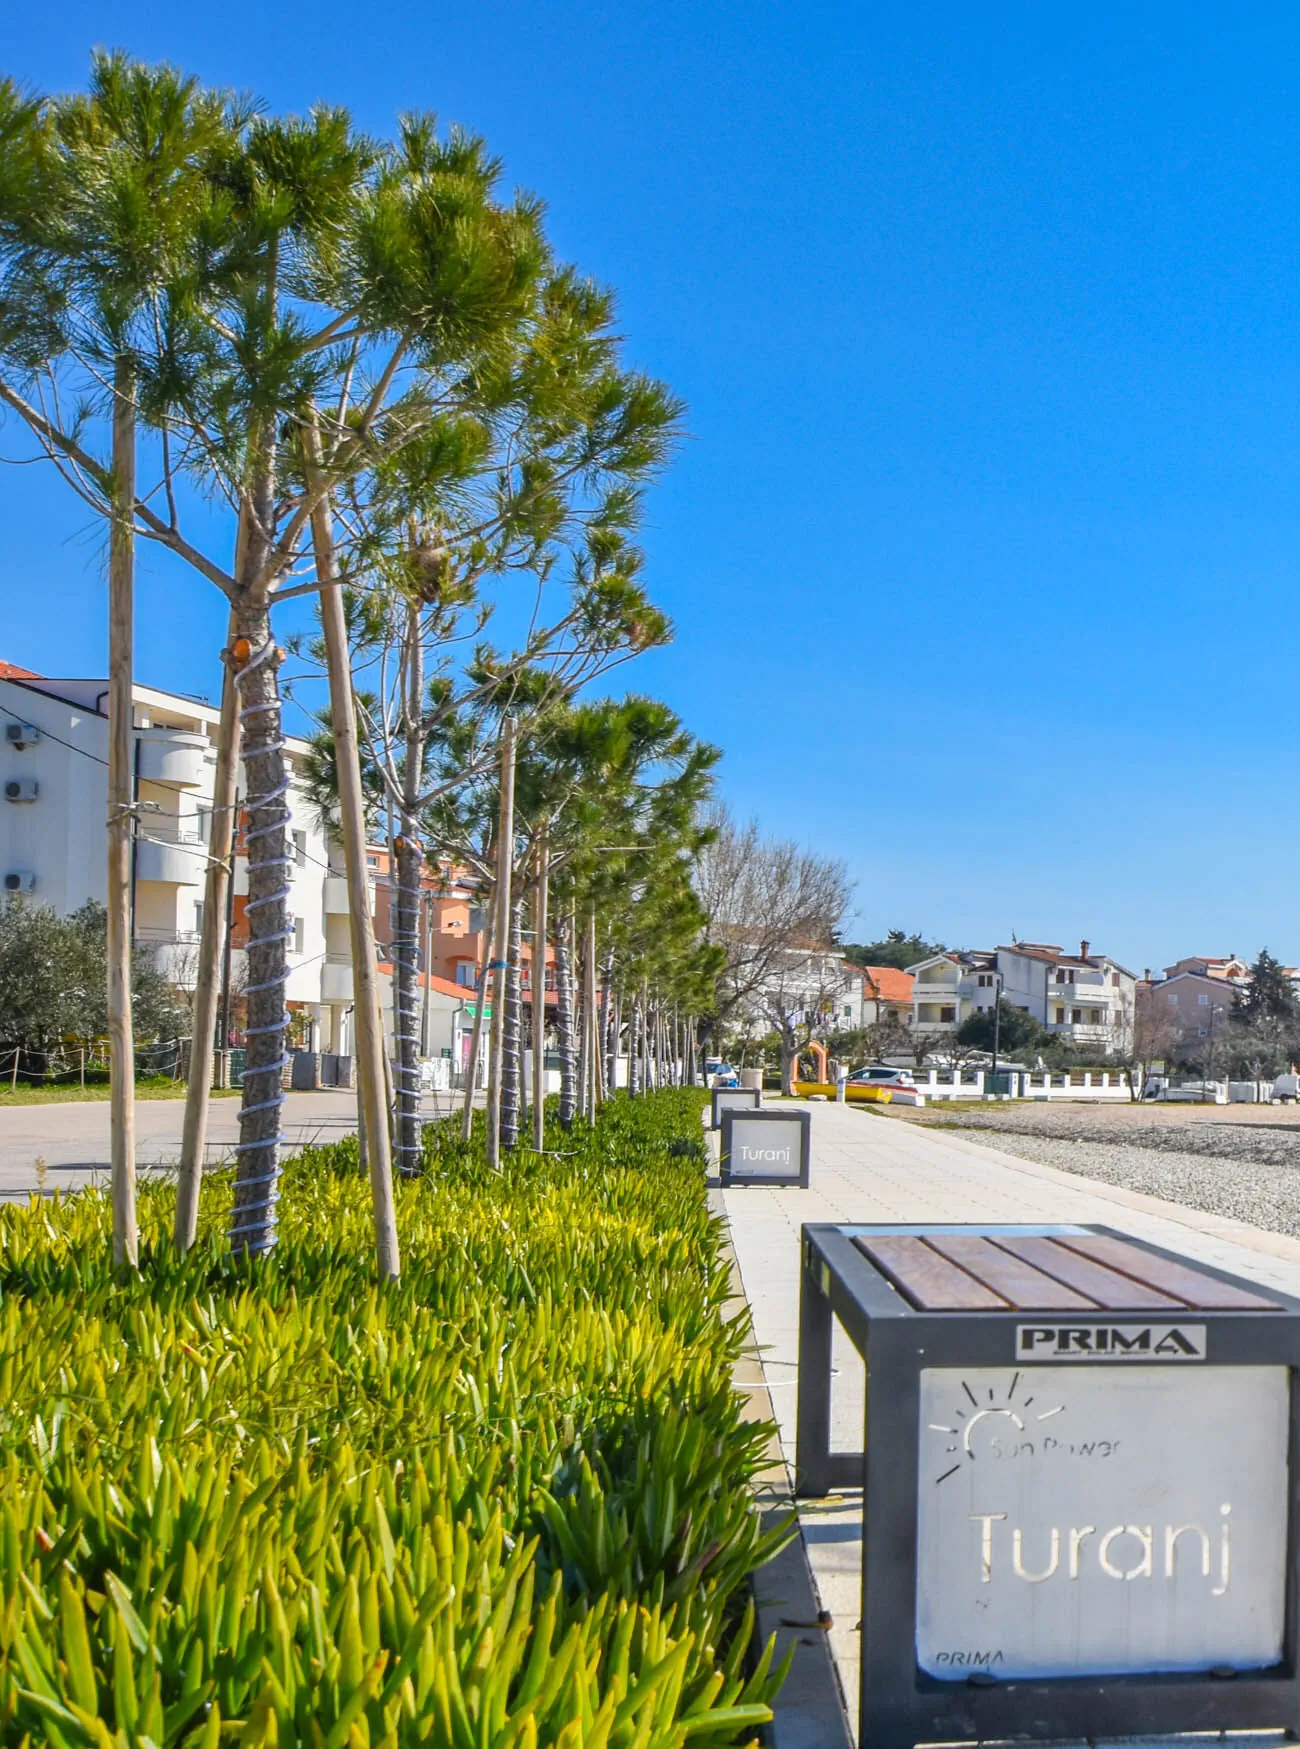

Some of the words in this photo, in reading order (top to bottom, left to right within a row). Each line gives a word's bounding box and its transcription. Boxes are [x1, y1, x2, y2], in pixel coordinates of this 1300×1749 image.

[740, 1145, 791, 1164] Turanj
[1021, 1328, 1200, 1355] PRIMA
[967, 1502, 1232, 1596] Turanj
[936, 1649, 1005, 1665] PRIMA
